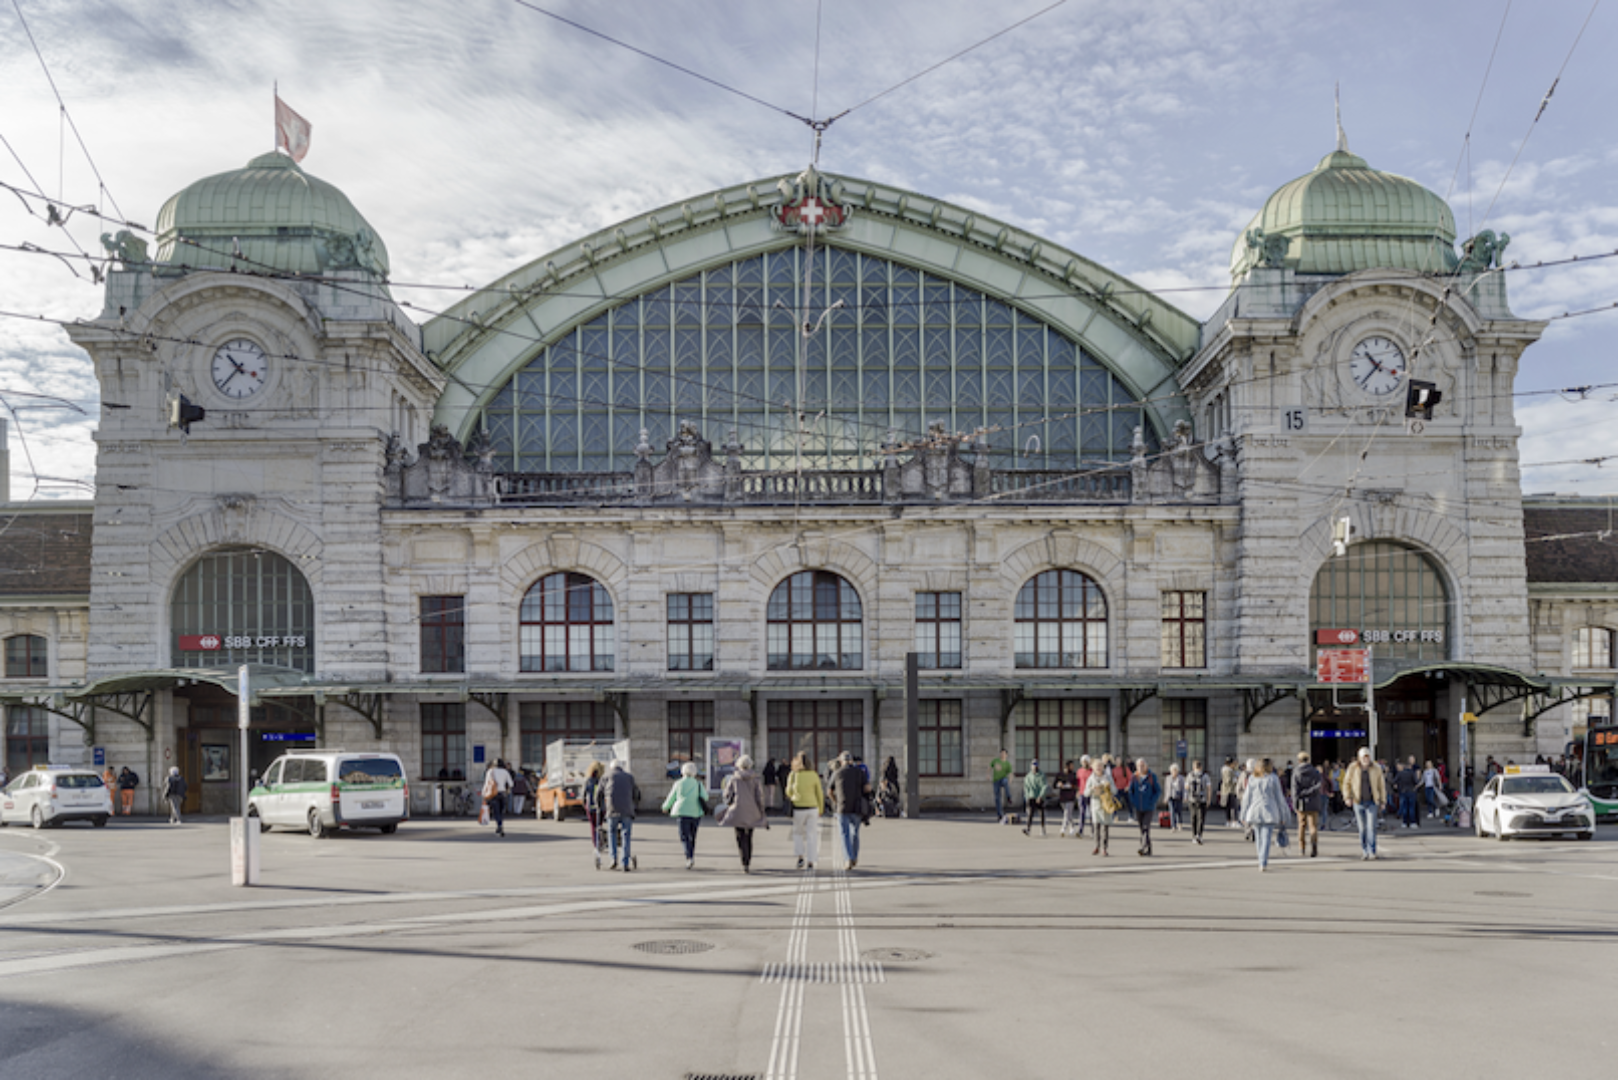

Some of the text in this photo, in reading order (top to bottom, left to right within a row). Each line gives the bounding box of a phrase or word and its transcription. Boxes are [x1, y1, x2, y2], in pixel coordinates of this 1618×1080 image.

[1285, 410, 1304, 430] 15
[224, 635, 306, 648] SBB CFF FFS
[1363, 629, 1443, 642] SBB CFF FFS
